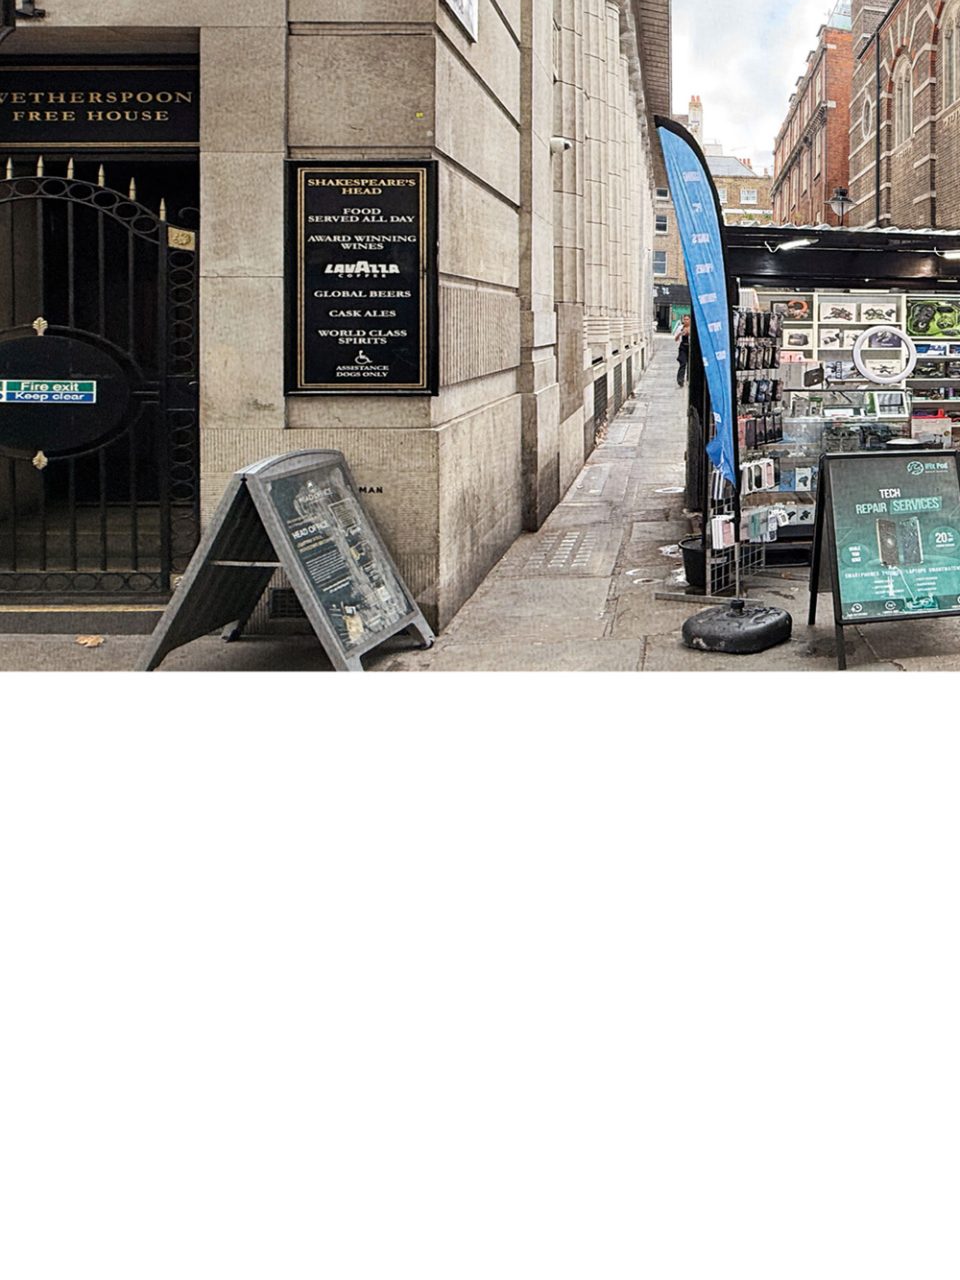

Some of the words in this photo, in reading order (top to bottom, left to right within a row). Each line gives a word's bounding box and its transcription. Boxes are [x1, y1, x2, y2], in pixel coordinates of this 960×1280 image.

[13, 111, 76, 121] FREE
[87, 111, 169, 121] HOUSE
[324, 261, 400, 273] LAVAZZA
[21, 382, 49, 391] Fire
[53, 382, 79, 391] exit
[15, 392, 48, 401] Keep
[879, 488, 900, 499] TECH
[856, 503, 887, 514] REPAIR
[893, 498, 939, 512] SERVICES
